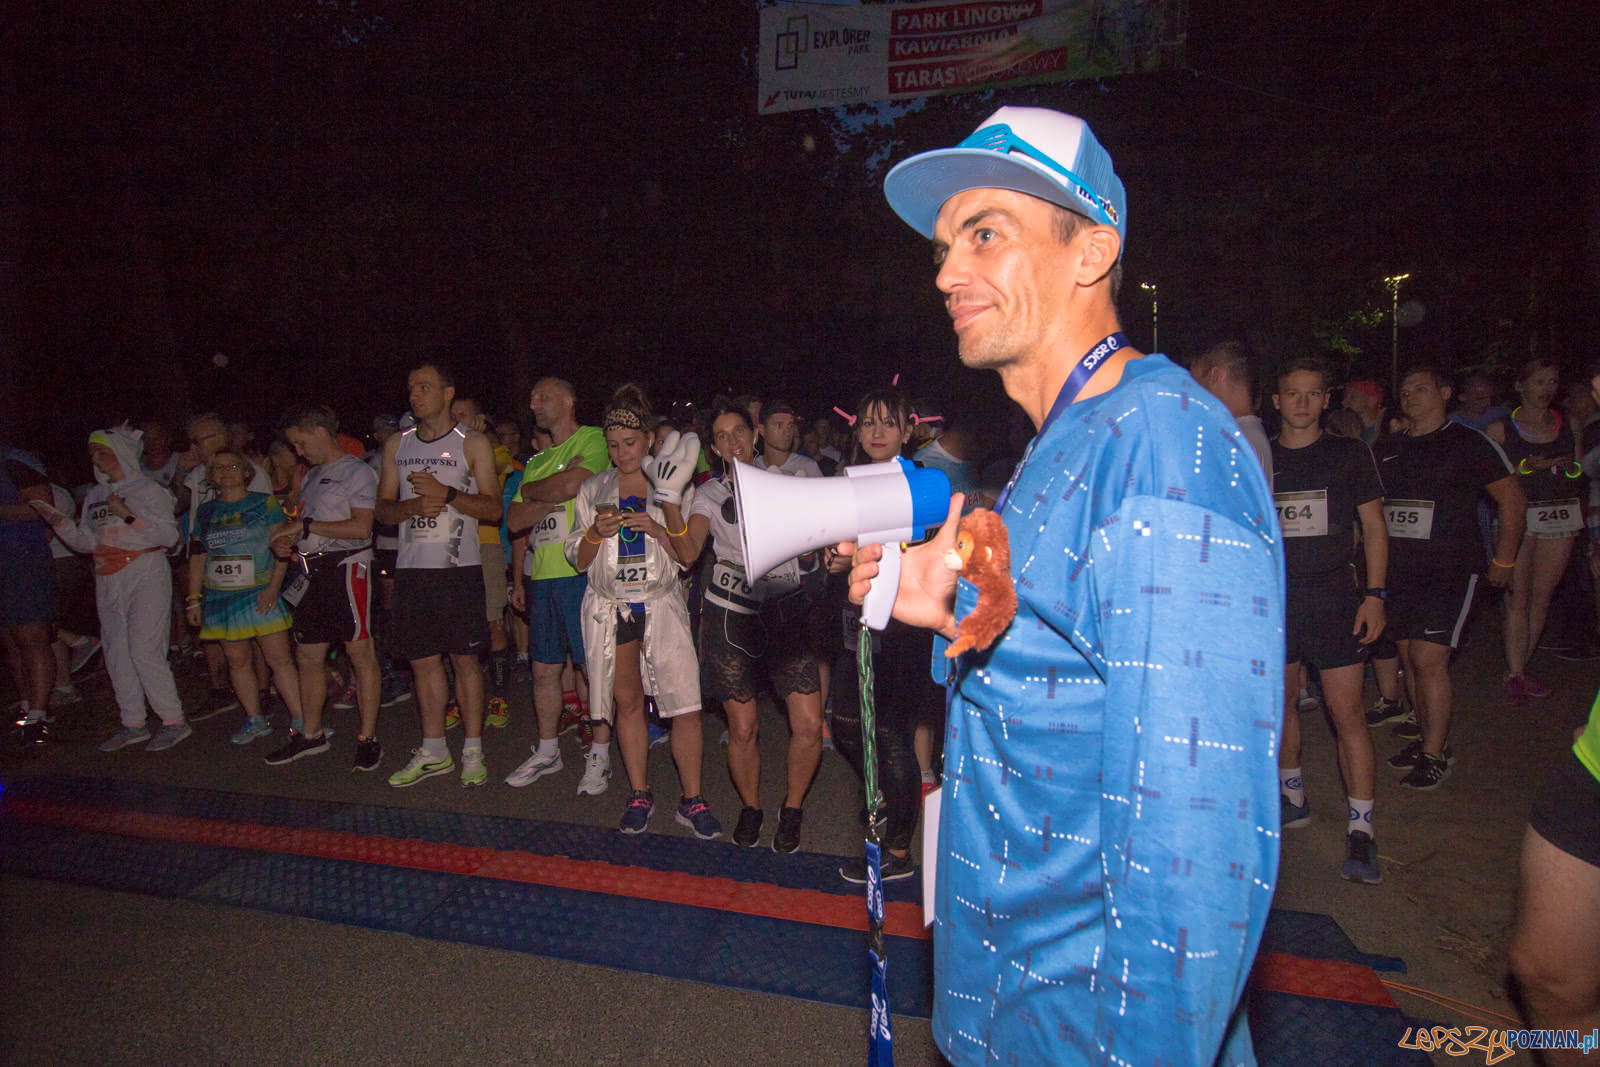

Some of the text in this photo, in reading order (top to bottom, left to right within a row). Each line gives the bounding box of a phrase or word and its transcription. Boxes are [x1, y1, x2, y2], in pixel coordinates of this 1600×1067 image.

[897, 12, 948, 30] PARK
[813, 28, 871, 49] EXPLORER
[1388, 511, 1419, 524] 155
[1537, 509, 1569, 522] 248
[410, 517, 438, 529] 266
[214, 564, 242, 575] 481
[615, 567, 647, 582] 427
